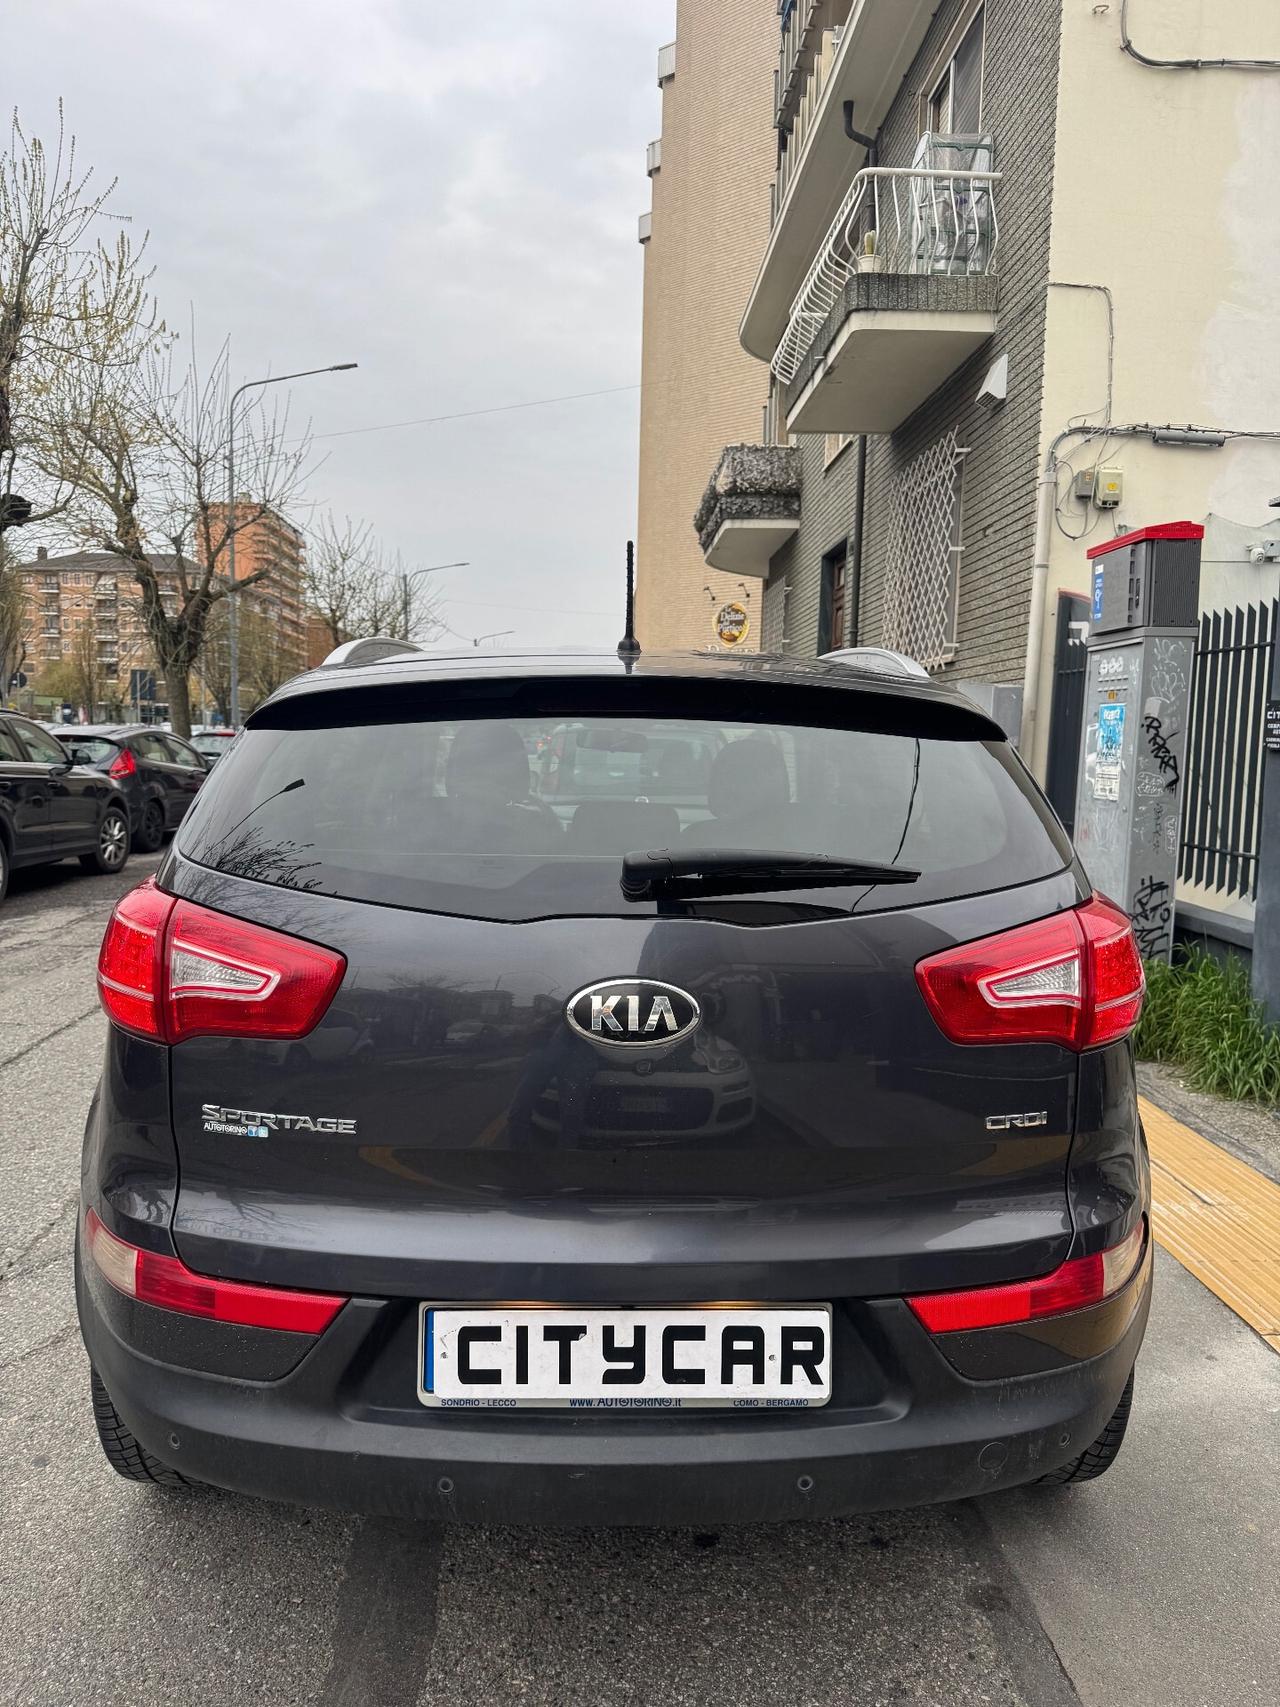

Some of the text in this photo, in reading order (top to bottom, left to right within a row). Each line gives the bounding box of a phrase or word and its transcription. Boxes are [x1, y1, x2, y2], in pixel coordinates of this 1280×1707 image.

[590, 995, 678, 1031] KIA
[201, 1103, 357, 1135] SPORTAGE
[203, 1122, 248, 1136] AUTOTORINO
[458, 1325, 825, 1385] CITYCAR
[441, 1398, 480, 1407] SONDRIO
[487, 1398, 517, 1407] LECCO
[733, 1399, 759, 1407] COMO
[766, 1398, 809, 1407] BERGAMO
